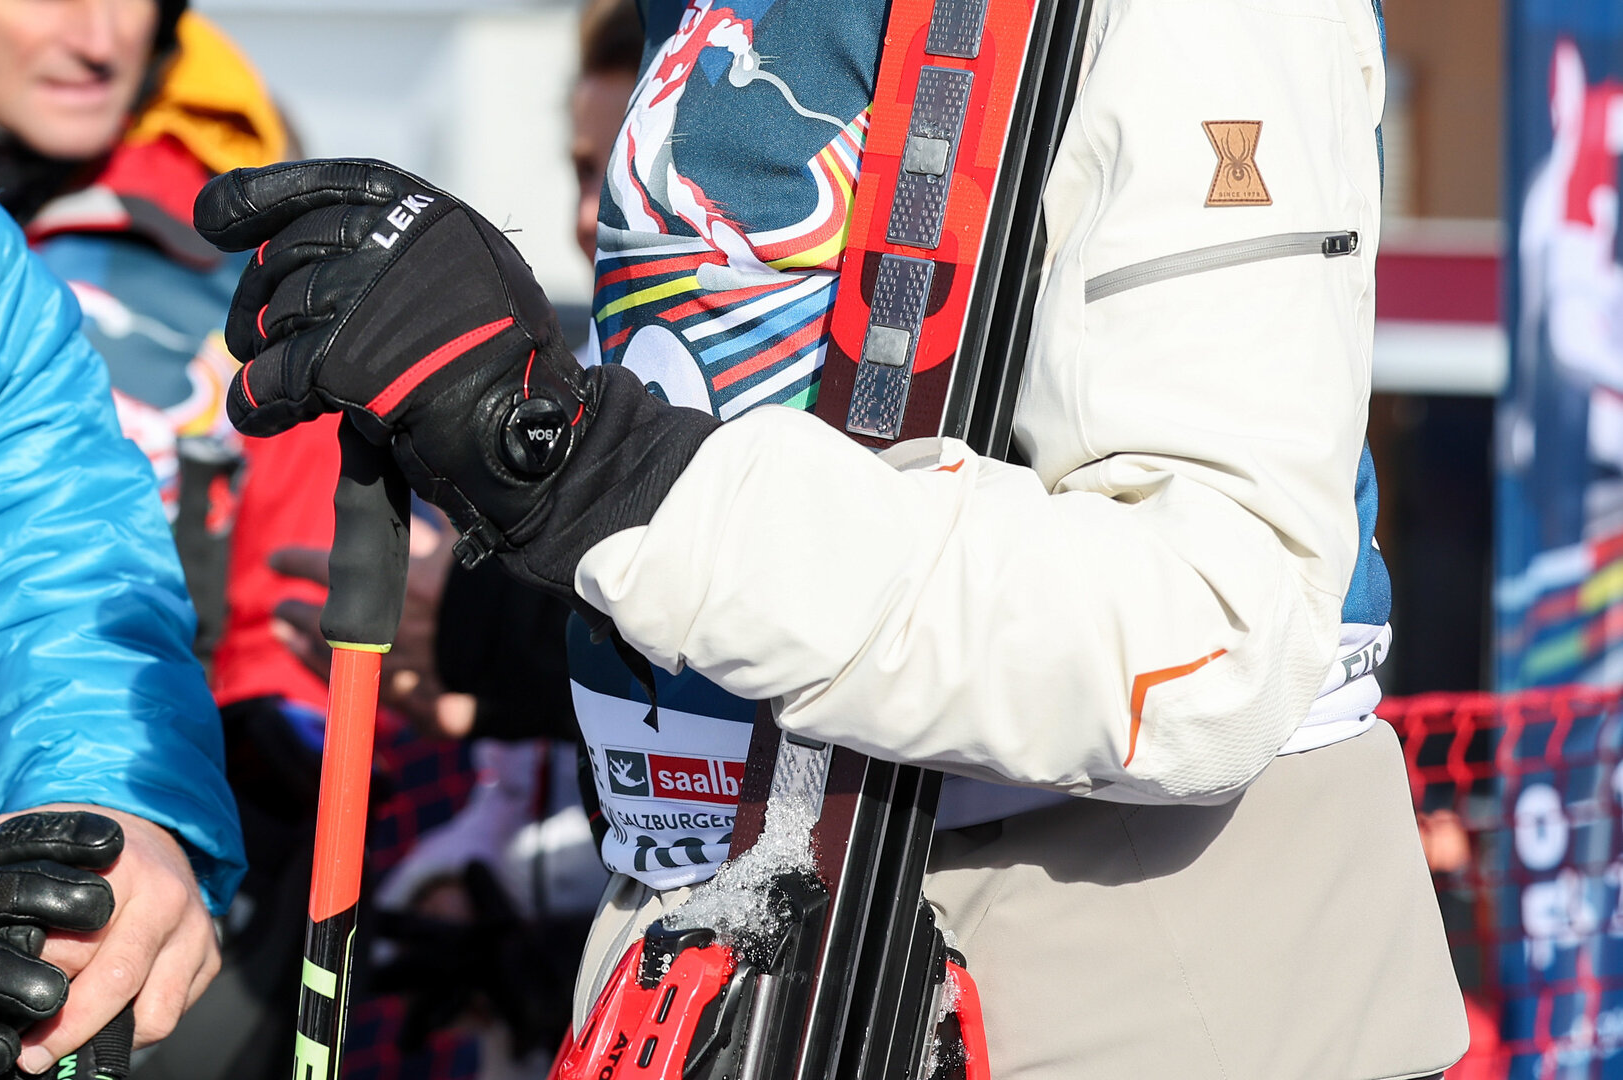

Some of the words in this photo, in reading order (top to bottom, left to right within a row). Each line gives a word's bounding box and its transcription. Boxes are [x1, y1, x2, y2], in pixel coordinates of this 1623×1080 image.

[372, 193, 434, 250] LEKI
[527, 428, 554, 442] BOA
[658, 759, 744, 797] saalb
